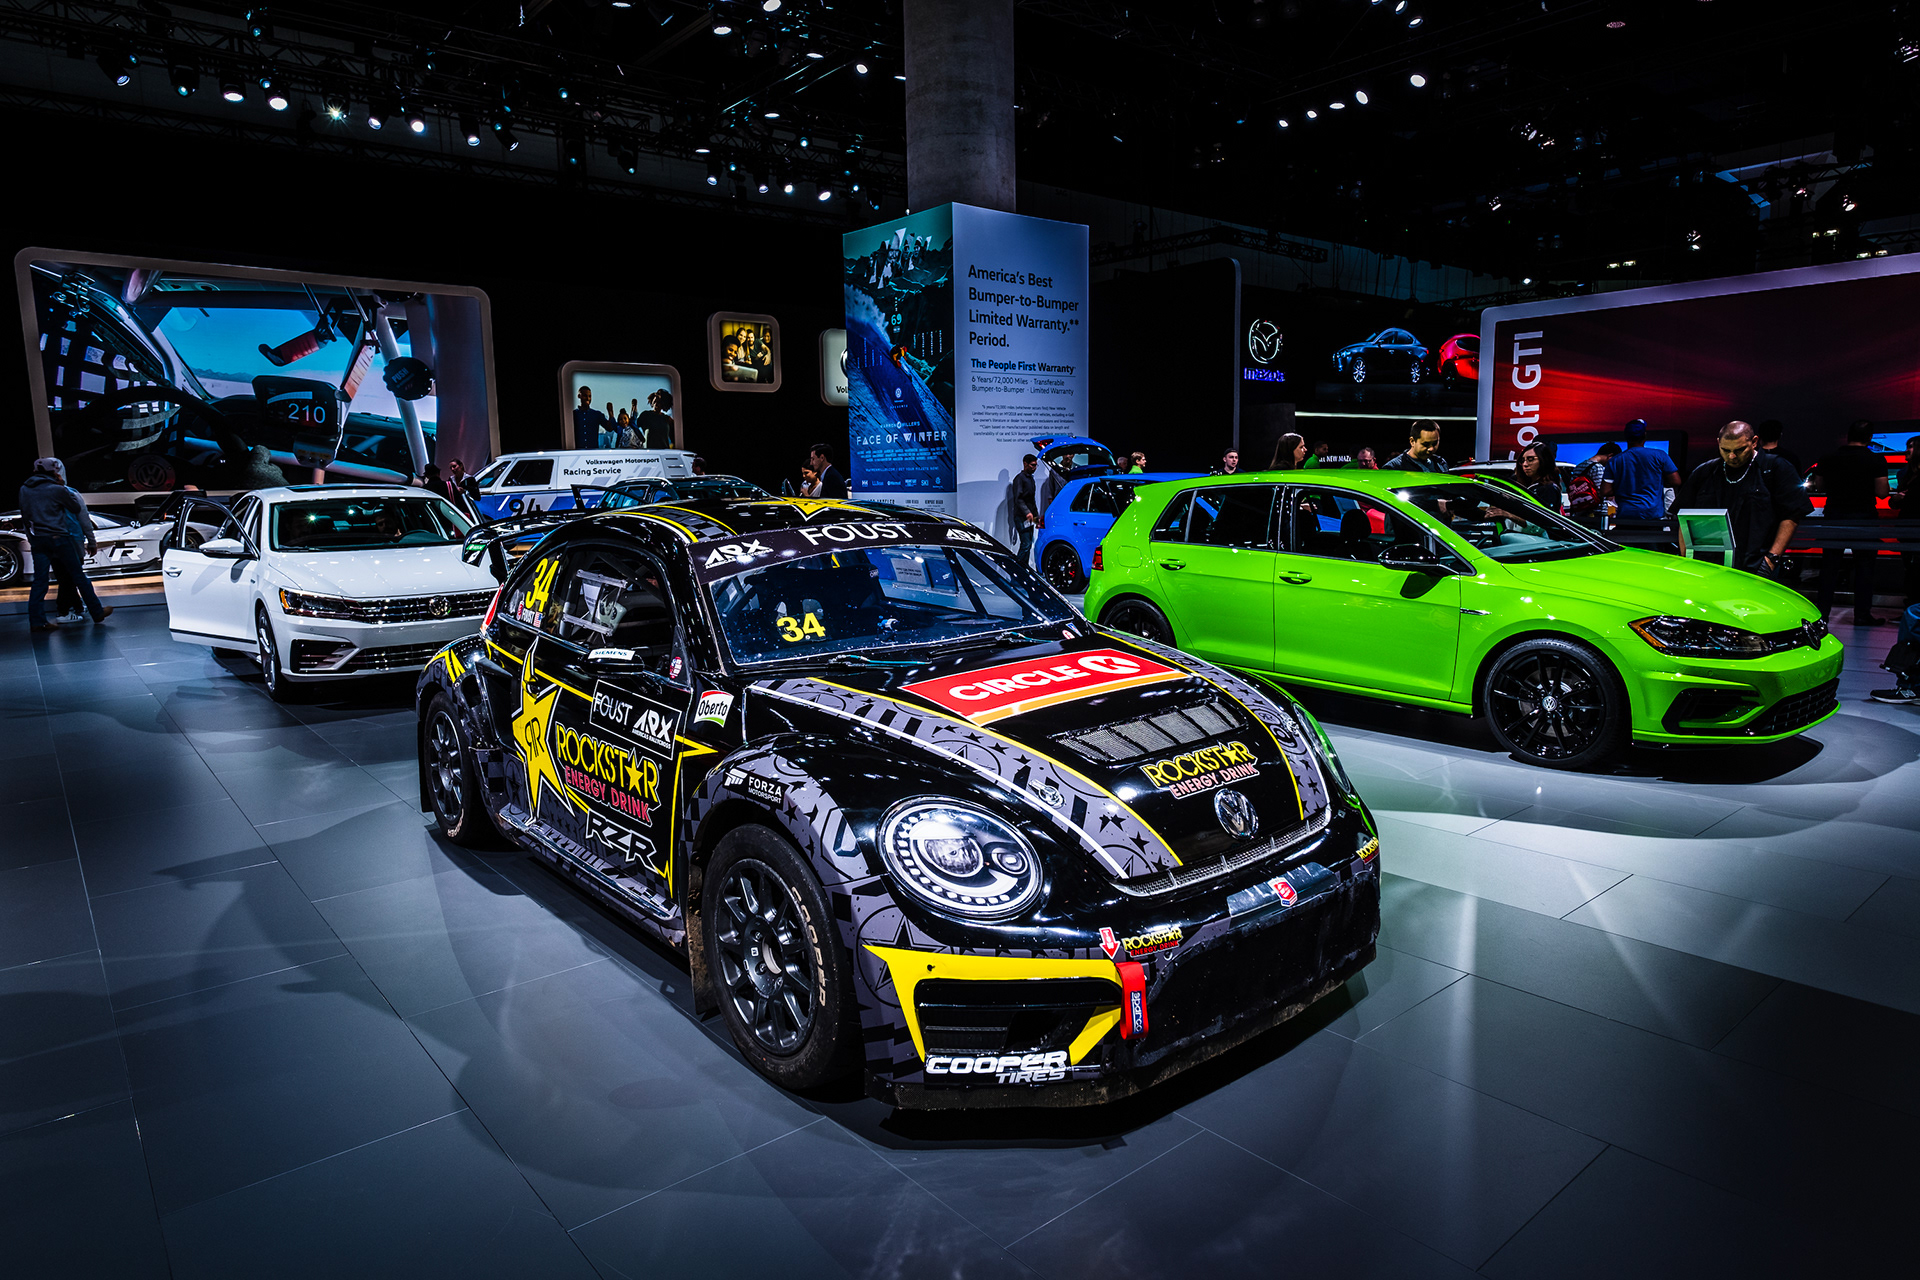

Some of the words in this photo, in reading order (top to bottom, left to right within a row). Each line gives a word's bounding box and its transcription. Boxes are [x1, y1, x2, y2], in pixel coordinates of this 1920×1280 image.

[968, 264, 1025, 285] America's
[1028, 273, 1053, 288] Best
[969, 287, 1079, 313] Bumper-to-Bumper
[891, 313, 902, 325] 69
[969, 309, 1013, 326] Limited
[969, 331, 1009, 347] Period.
[971, 358, 987, 369] The
[988, 360, 1016, 372] People
[1018, 361, 1037, 372] First
[1511, 330, 1543, 390] GTI
[392, 367, 409, 383] PUSH
[977, 376, 1014, 385] Years/72,000
[1034, 378, 1065, 387] Transferable
[971, 385, 1025, 394] Bumper-to-Bumper
[1030, 387, 1049, 395] Limited
[1050, 388, 1074, 397] Warranty
[288, 403, 326, 424] 210
[856, 434, 881, 446] FACE
[886, 433, 898, 444] OF
[903, 431, 948, 442] WINTER
[1508, 400, 1540, 460] olf
[563, 468, 592, 476] Racing
[593, 467, 622, 475] Service
[509, 498, 543, 516] 94
[129, 520, 141, 529] 94
[798, 523, 913, 546] FOUST
[525, 558, 559, 613] 34
[776, 612, 826, 642] 34
[949, 665, 1091, 700] CIRCLE
[1081, 656, 1140, 674] K
[593, 691, 634, 726] FOUST
[698, 699, 728, 717] Oberto
[633, 708, 674, 743] ARX
[555, 722, 660, 803] ROCKSTAR
[1142, 741, 1256, 787] ROCKSTAR
[748, 776, 782, 797] FORZA
[1169, 772, 1219, 797] ENERGY
[1219, 762, 1258, 782] DRINK
[565, 765, 606, 801] ENERGY
[610, 787, 650, 822] DRINK
[748, 787, 782, 804] MOTORSPORT
[586, 808, 659, 874] RZR
[791, 886, 826, 1007] COOPER
[1103, 930, 1115, 950] TOW
[1122, 928, 1182, 950] ROCKSTAR
[1130, 945, 1158, 957] ENERGY
[1159, 940, 1179, 950] DRINK
[1132, 991, 1143, 1032] sparco
[925, 1050, 1068, 1074] COOPER
[995, 1070, 1066, 1084] TIRES
